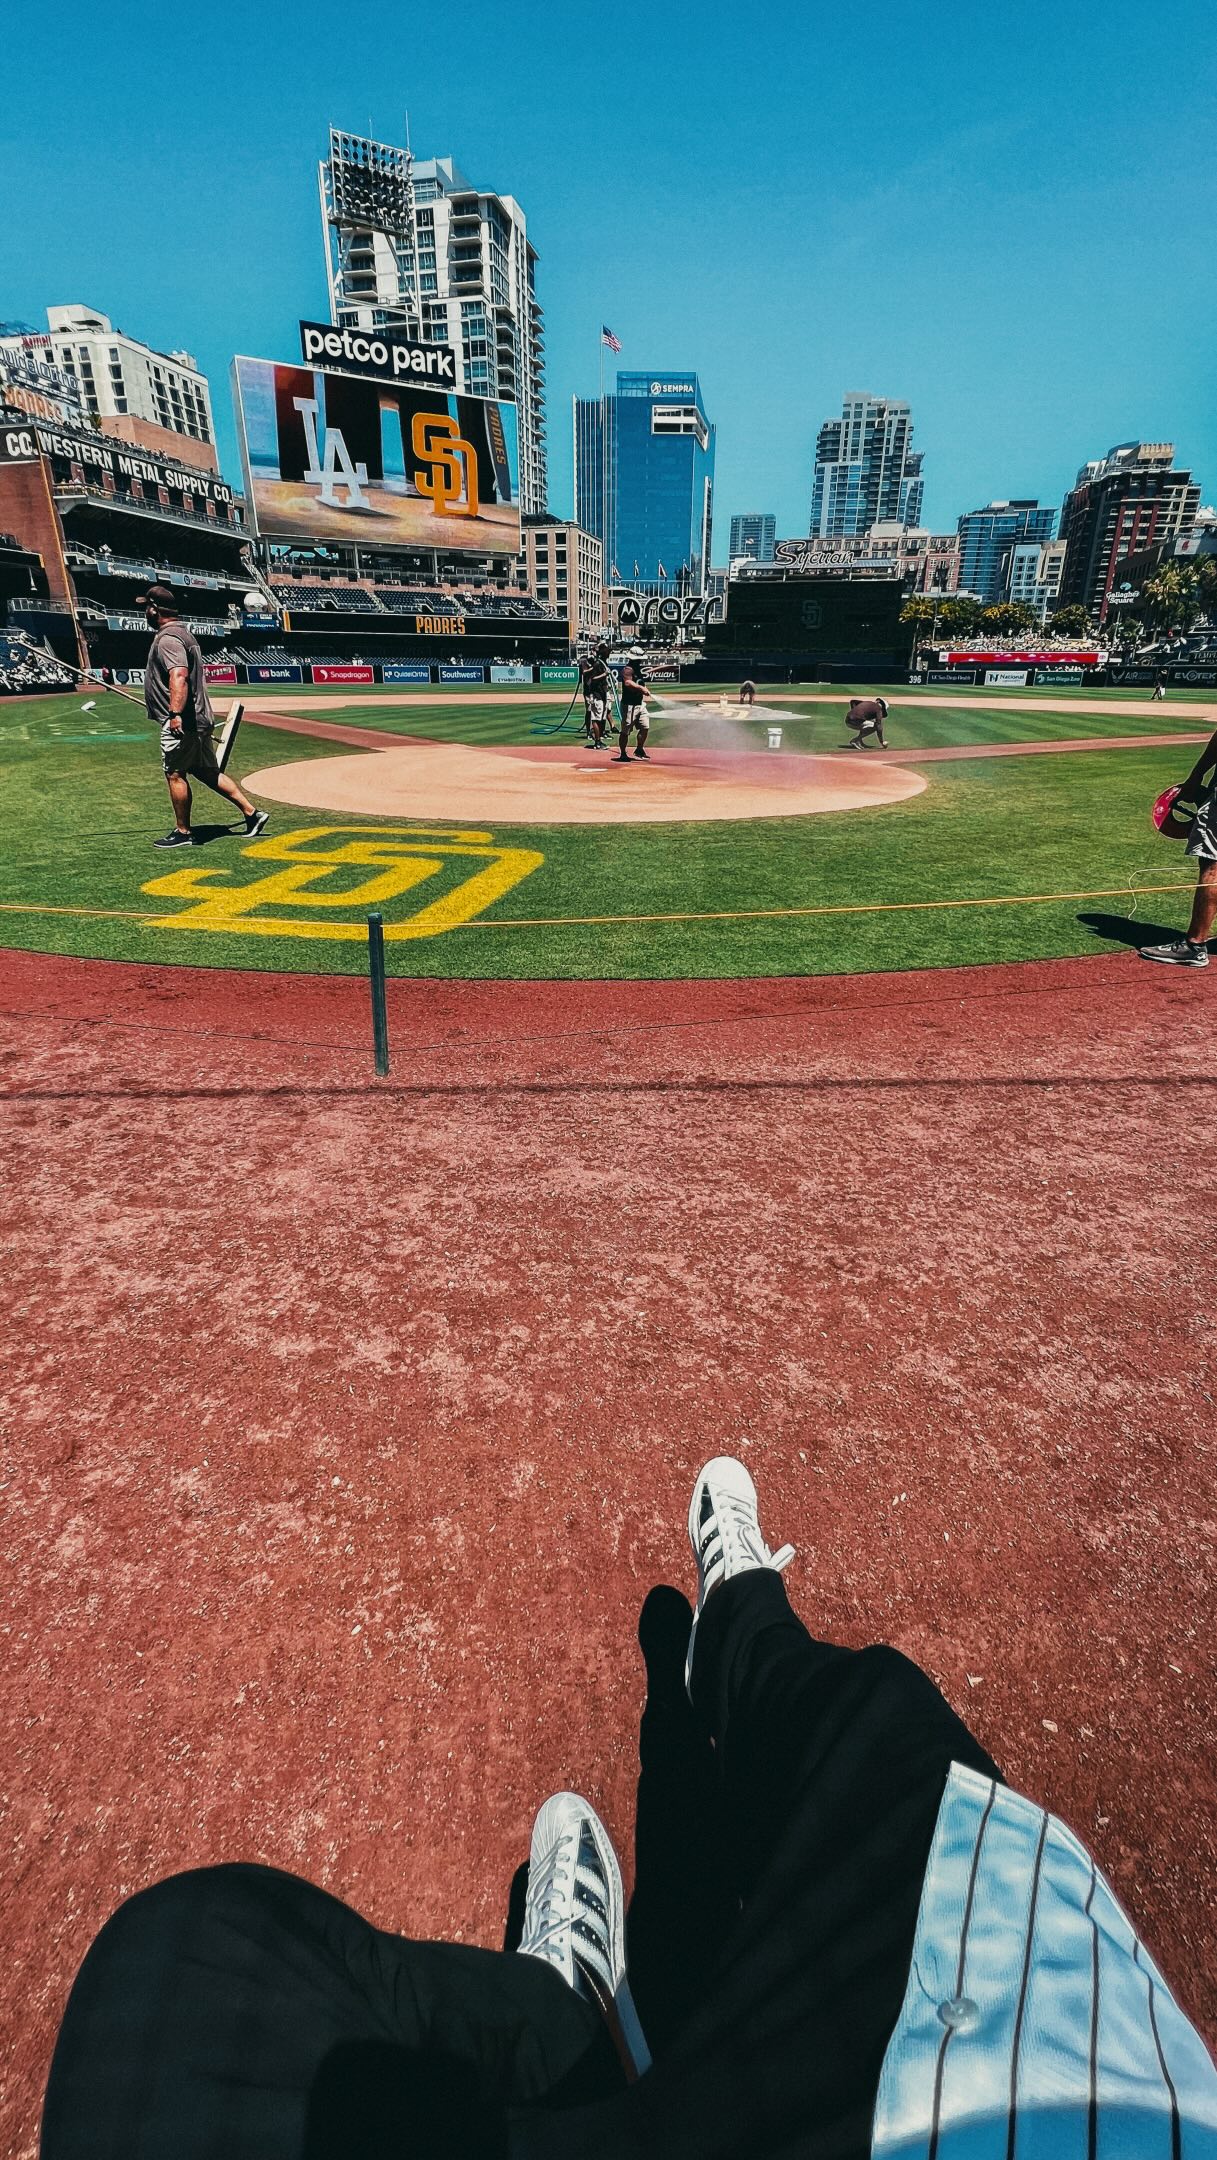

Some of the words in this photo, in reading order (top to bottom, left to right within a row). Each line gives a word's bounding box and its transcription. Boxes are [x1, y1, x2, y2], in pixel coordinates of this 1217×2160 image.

[303, 328, 388, 365] petco
[392, 345, 453, 378] park
[5, 432, 39, 457] CO.
[490, 406, 507, 465] PADRES
[292, 396, 370, 508] LA
[412, 412, 479, 518] SD
[39, 430, 113, 470] WESTERN
[119, 457, 164, 485] METAL
[164, 470, 210, 497] SUPPLY
[213, 484, 233, 504] CO.
[775, 541, 857, 573] Sycuan
[1106, 590, 1140, 599] Gallagher
[643, 596, 721, 625] razr
[416, 617, 466, 634] PADRES
[259, 670, 269, 678] us
[270, 669, 291, 678] bank
[330, 671, 370, 679] Snapdragon
[441, 670, 477, 679] Southwest
[640, 667, 675, 681] Sycuan
[909, 675, 922, 684] 396
[140, 826, 545, 941] SD
